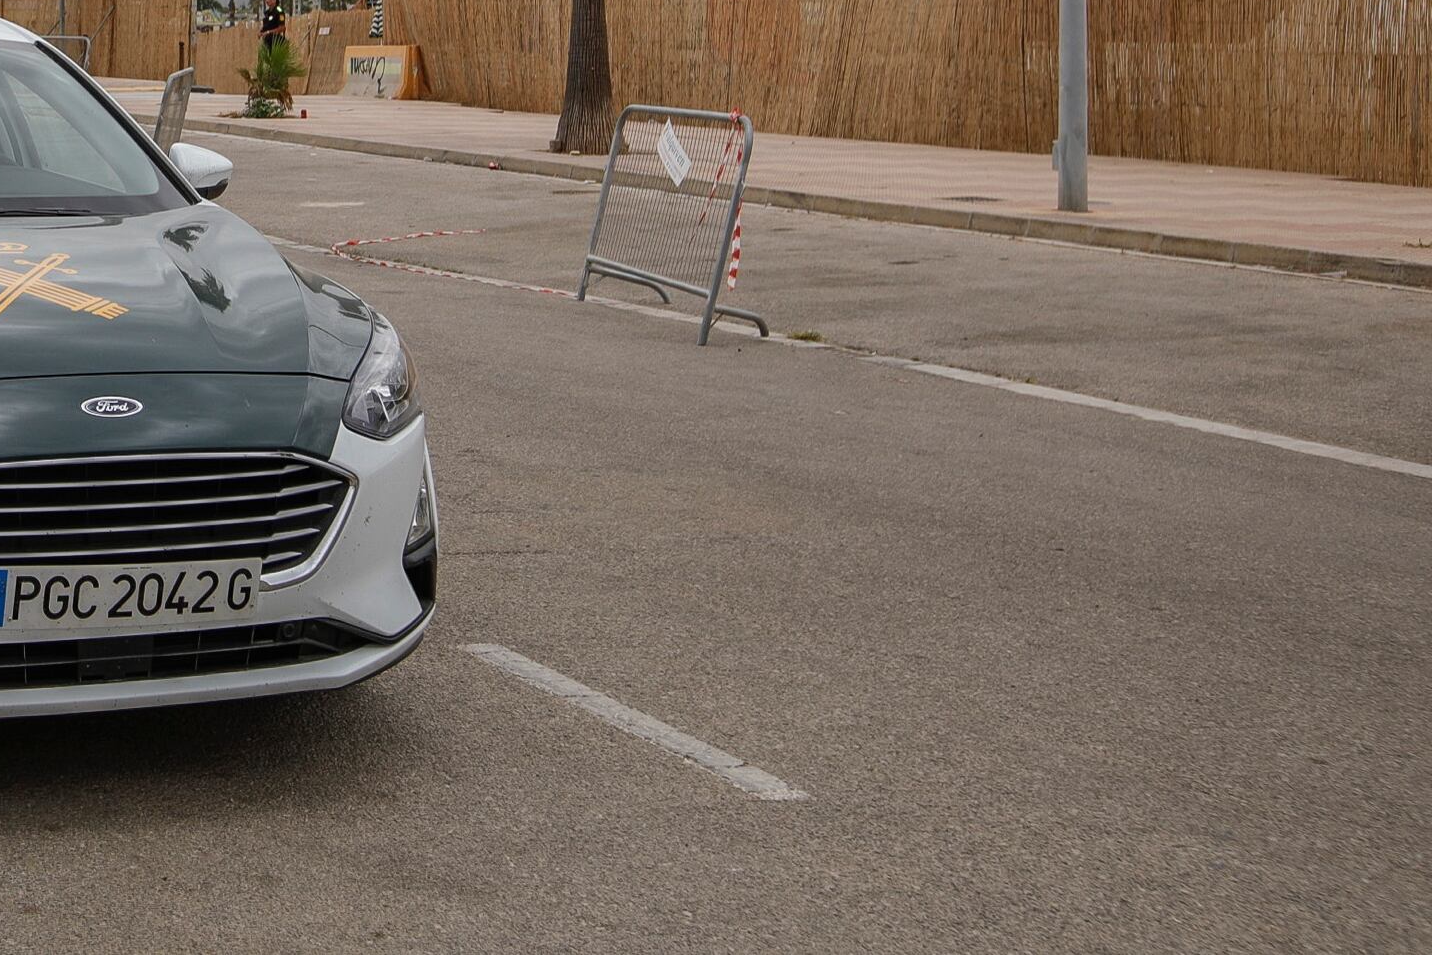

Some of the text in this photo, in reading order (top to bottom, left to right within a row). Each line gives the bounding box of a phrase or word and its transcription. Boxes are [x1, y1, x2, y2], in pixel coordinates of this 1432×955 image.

[96, 400, 129, 412] Ford
[12, 575, 100, 621] PGC
[107, 570, 219, 618] 2042
[227, 568, 253, 610] G
